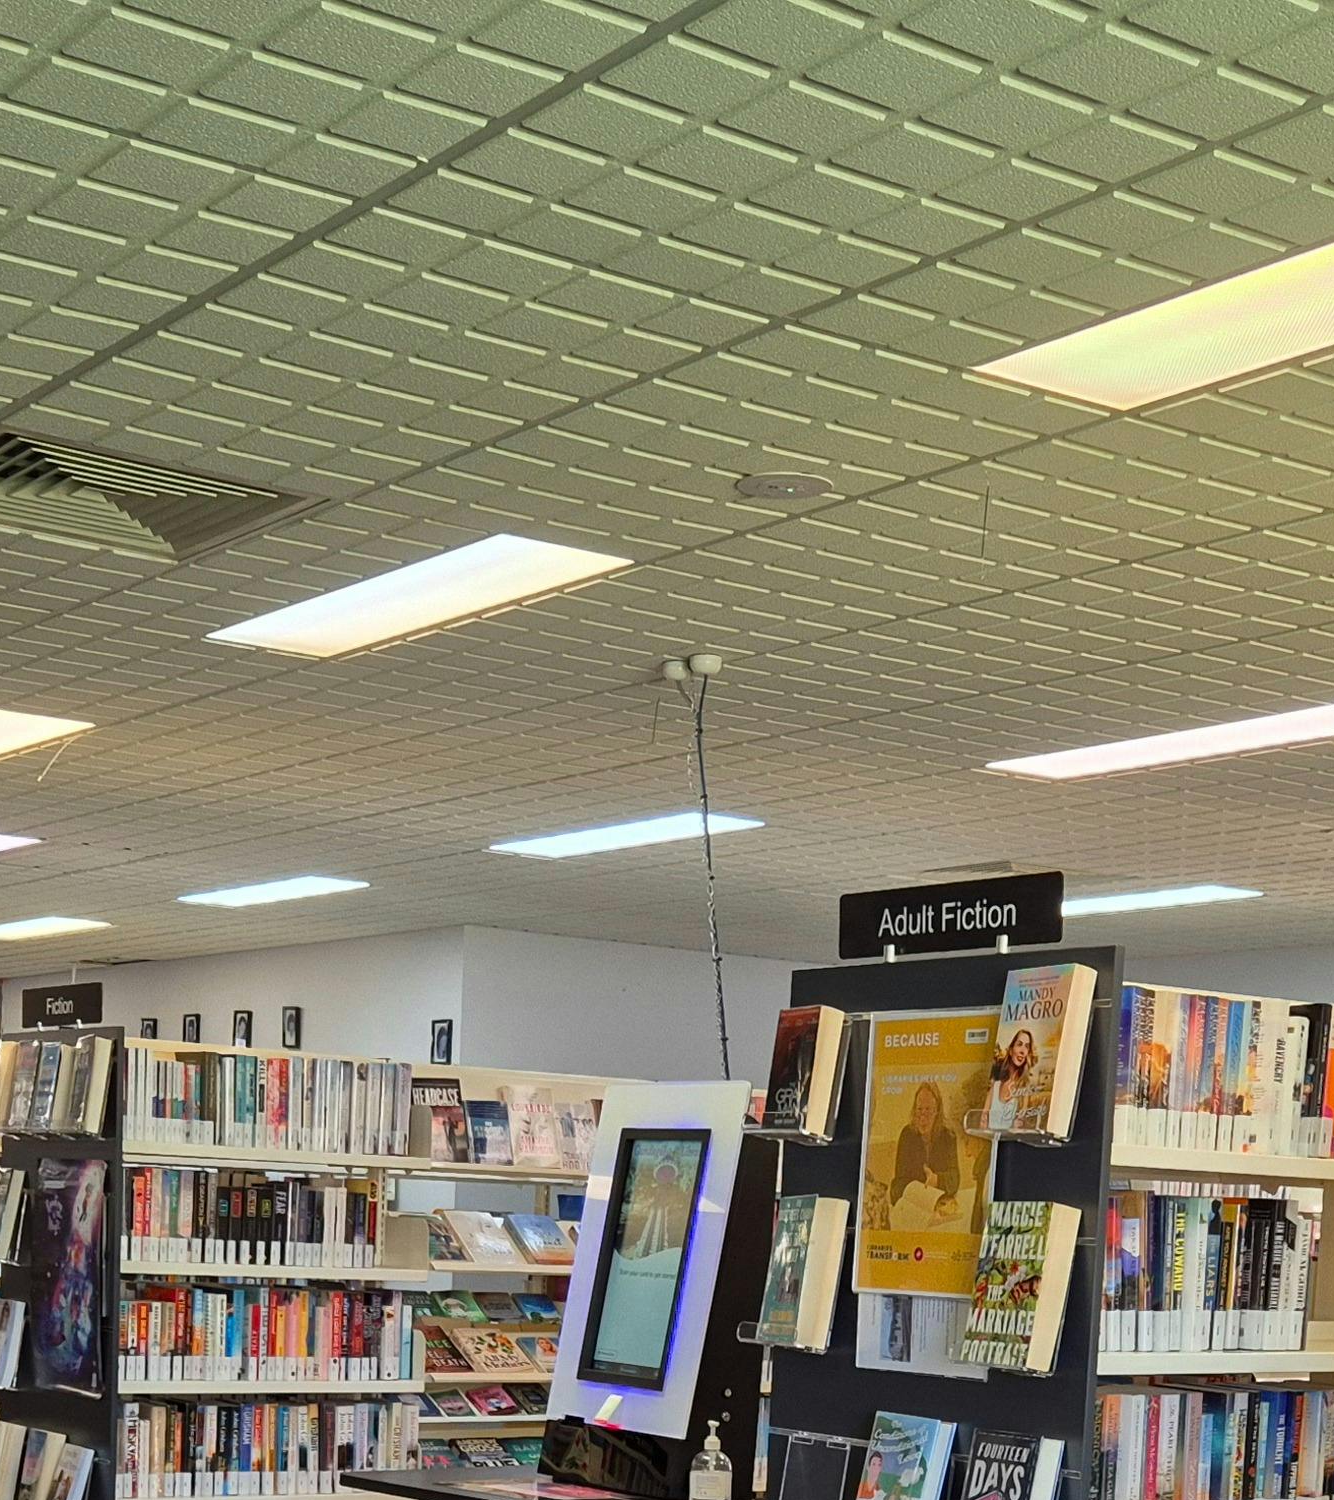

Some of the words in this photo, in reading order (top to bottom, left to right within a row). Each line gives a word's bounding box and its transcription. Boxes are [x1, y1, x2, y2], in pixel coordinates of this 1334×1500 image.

[878, 905, 935, 938] Adult
[941, 898, 1017, 932] Fiction
[45, 997, 74, 1015] Fiction
[1018, 986, 1056, 1002] MANDY
[1004, 999, 1064, 1022] MAGRO
[884, 1032, 940, 1048] BECAUSE
[1273, 1038, 1287, 1084] RAVENCRY
[412, 1087, 460, 1107] HEADCASE
[275, 1191, 287, 1215] FEAR
[990, 1200, 1046, 1228] MAGGIE
[1206, 1256, 1215, 1298] LIARS
[986, 1284, 1005, 1302] THE
[965, 1308, 1036, 1336] MARRIAGE
[976, 1440, 1031, 1464] FOURTEEN
